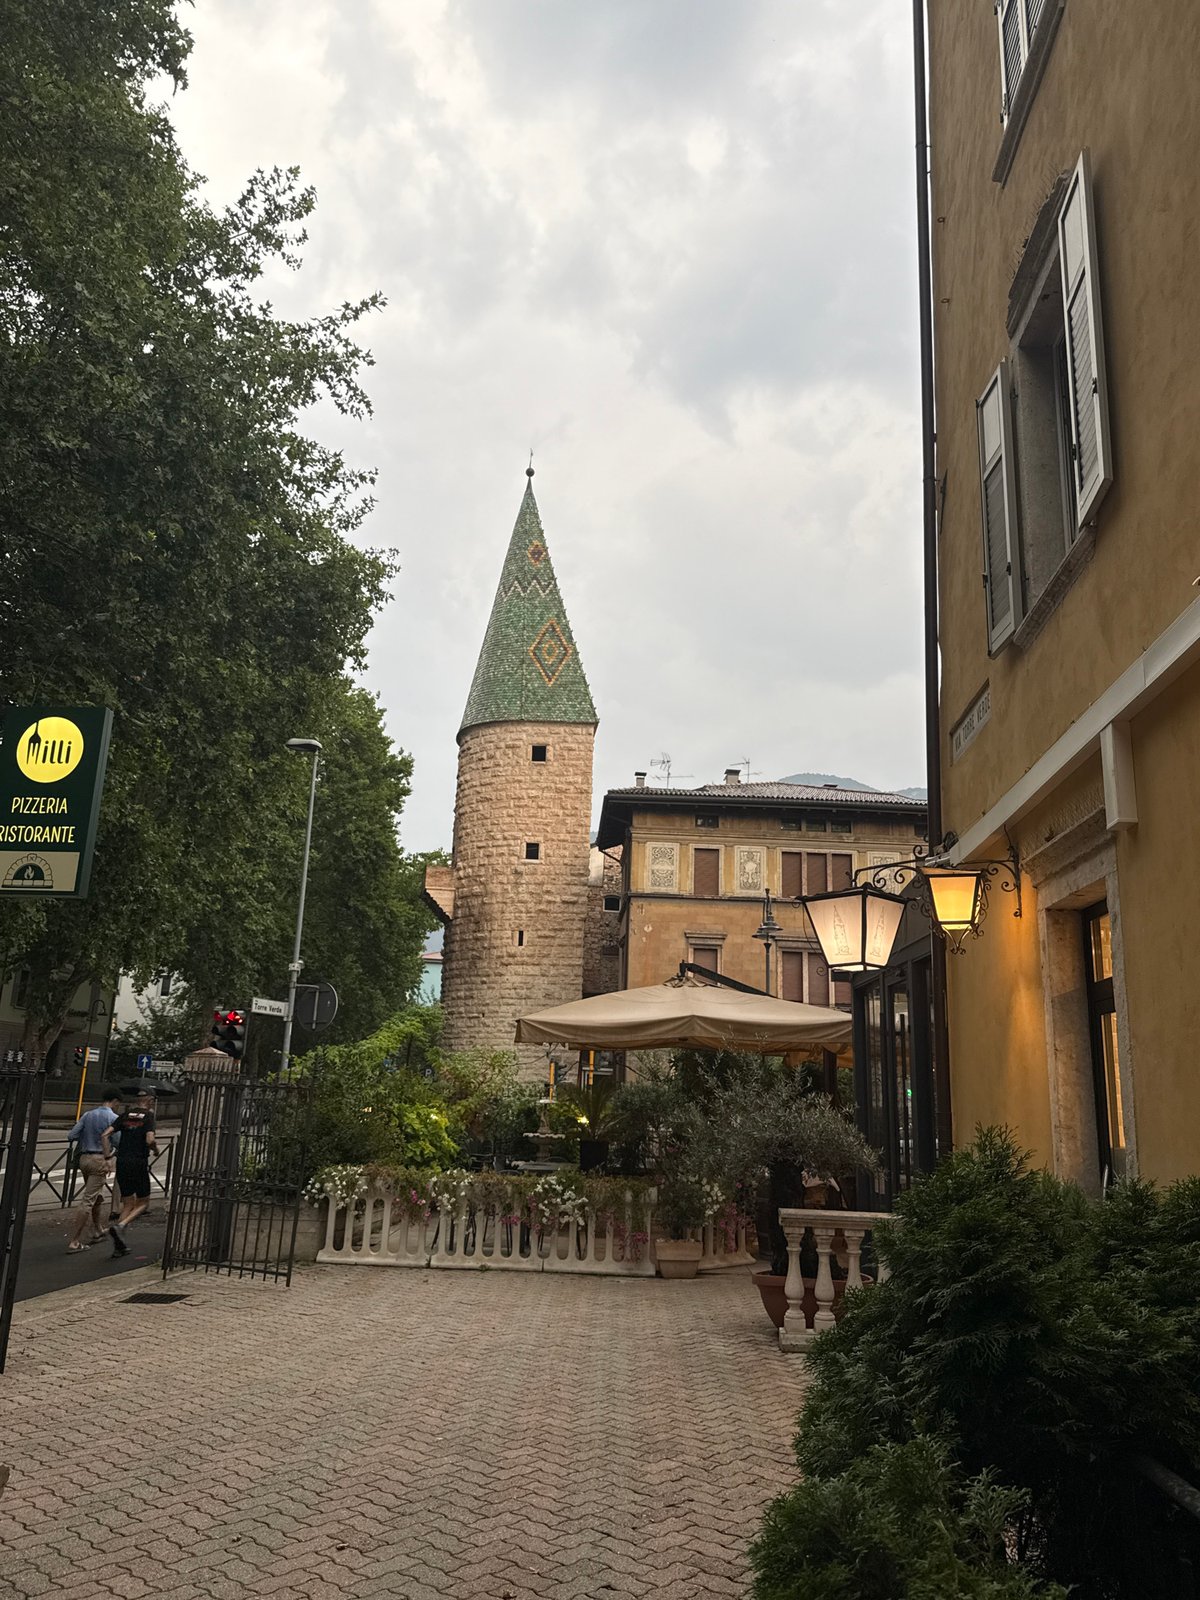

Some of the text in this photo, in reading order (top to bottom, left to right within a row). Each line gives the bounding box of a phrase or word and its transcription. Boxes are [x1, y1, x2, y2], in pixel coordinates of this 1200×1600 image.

[963, 713, 975, 742] TORRE
[977, 692, 990, 723] VERDE
[26, 730, 73, 765] Milli
[11, 797, 68, 814] PIZZERIA
[254, 1003, 282, 1013] Torre Verde
